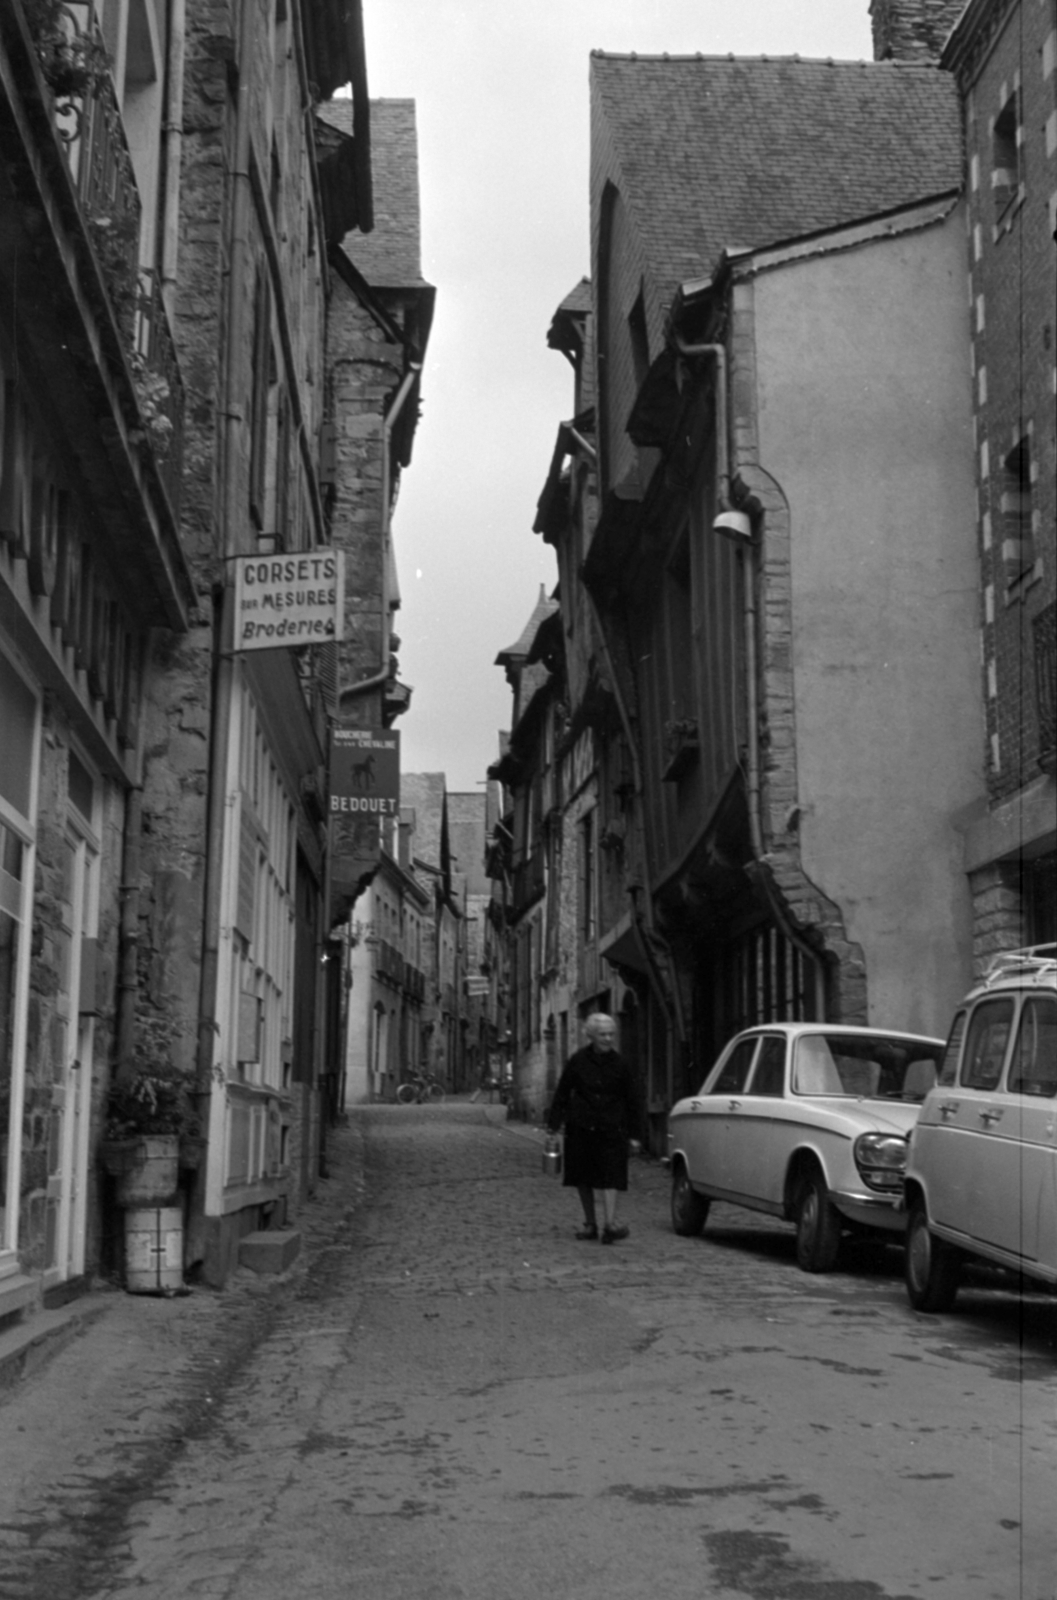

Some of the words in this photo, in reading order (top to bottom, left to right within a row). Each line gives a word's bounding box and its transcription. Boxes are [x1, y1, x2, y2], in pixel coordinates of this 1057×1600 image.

[244, 558, 335, 585] CORSETS
[262, 589, 336, 609] MESURES
[330, 795, 396, 813] BEDOUET
